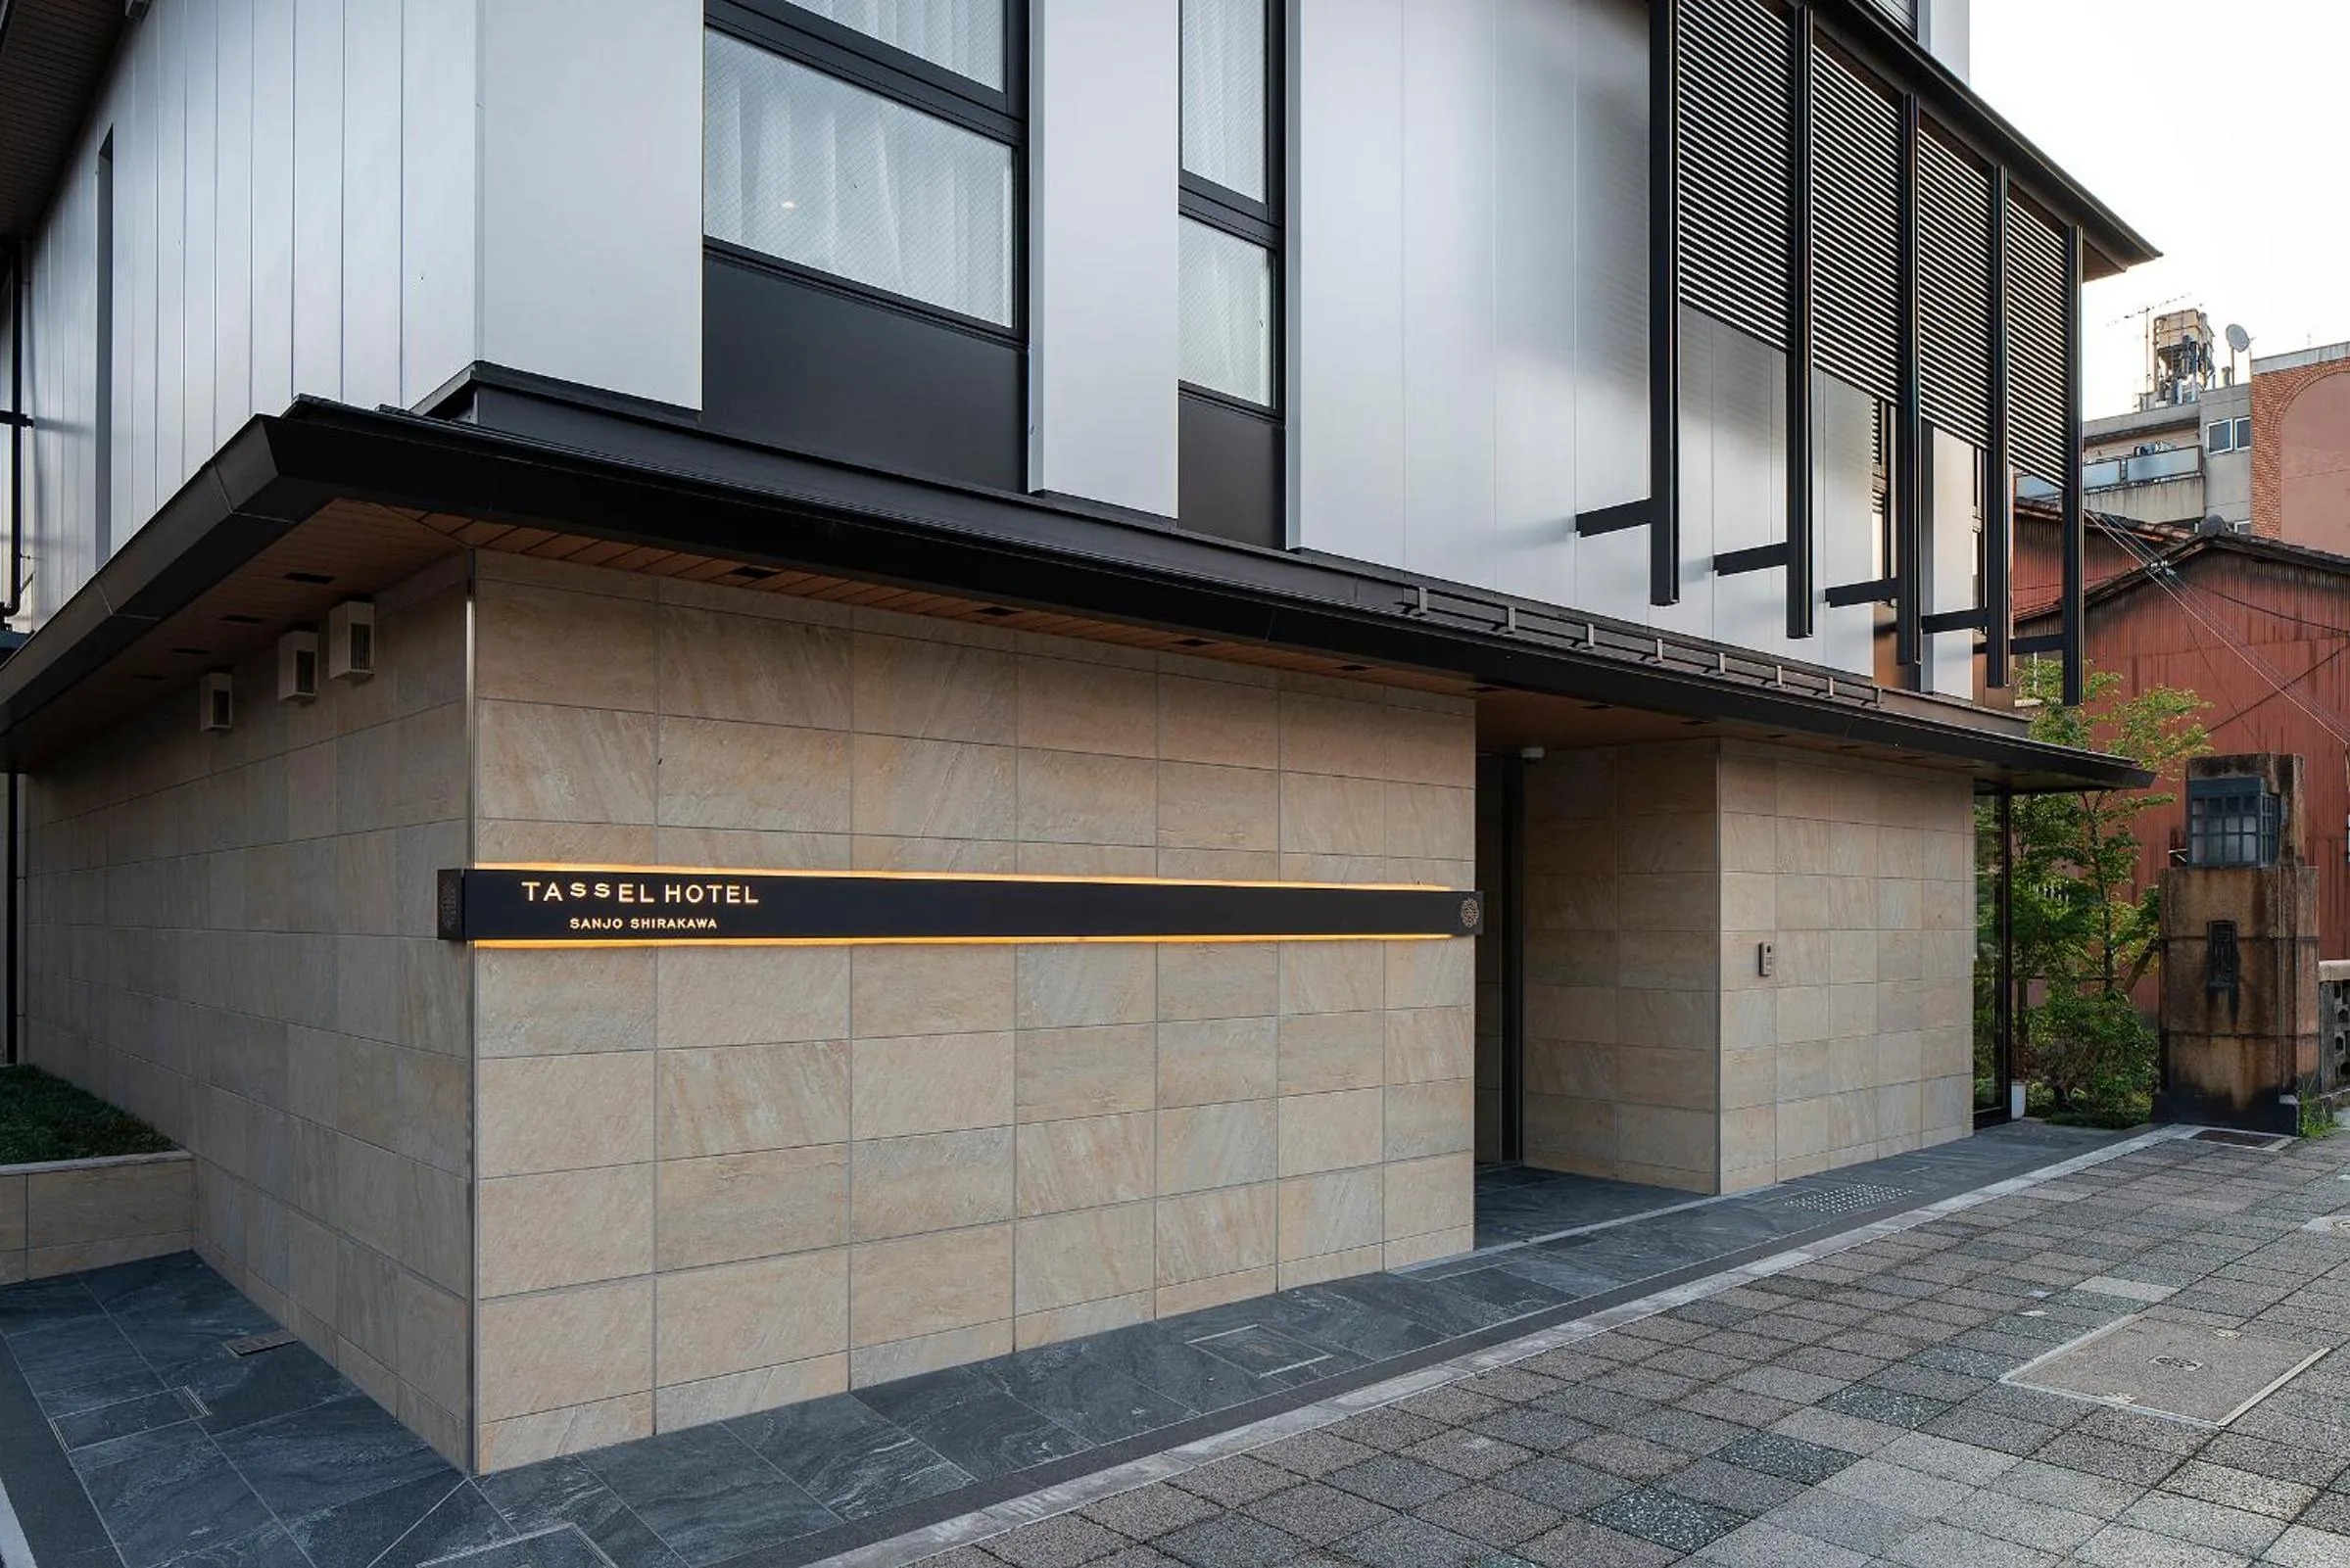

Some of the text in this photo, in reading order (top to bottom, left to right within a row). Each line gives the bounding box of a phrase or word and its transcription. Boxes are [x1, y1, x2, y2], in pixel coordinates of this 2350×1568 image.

[521, 880, 759, 904] TASSEL HOTEL
[569, 917, 717, 929] SANJO SHIRAKAWA
